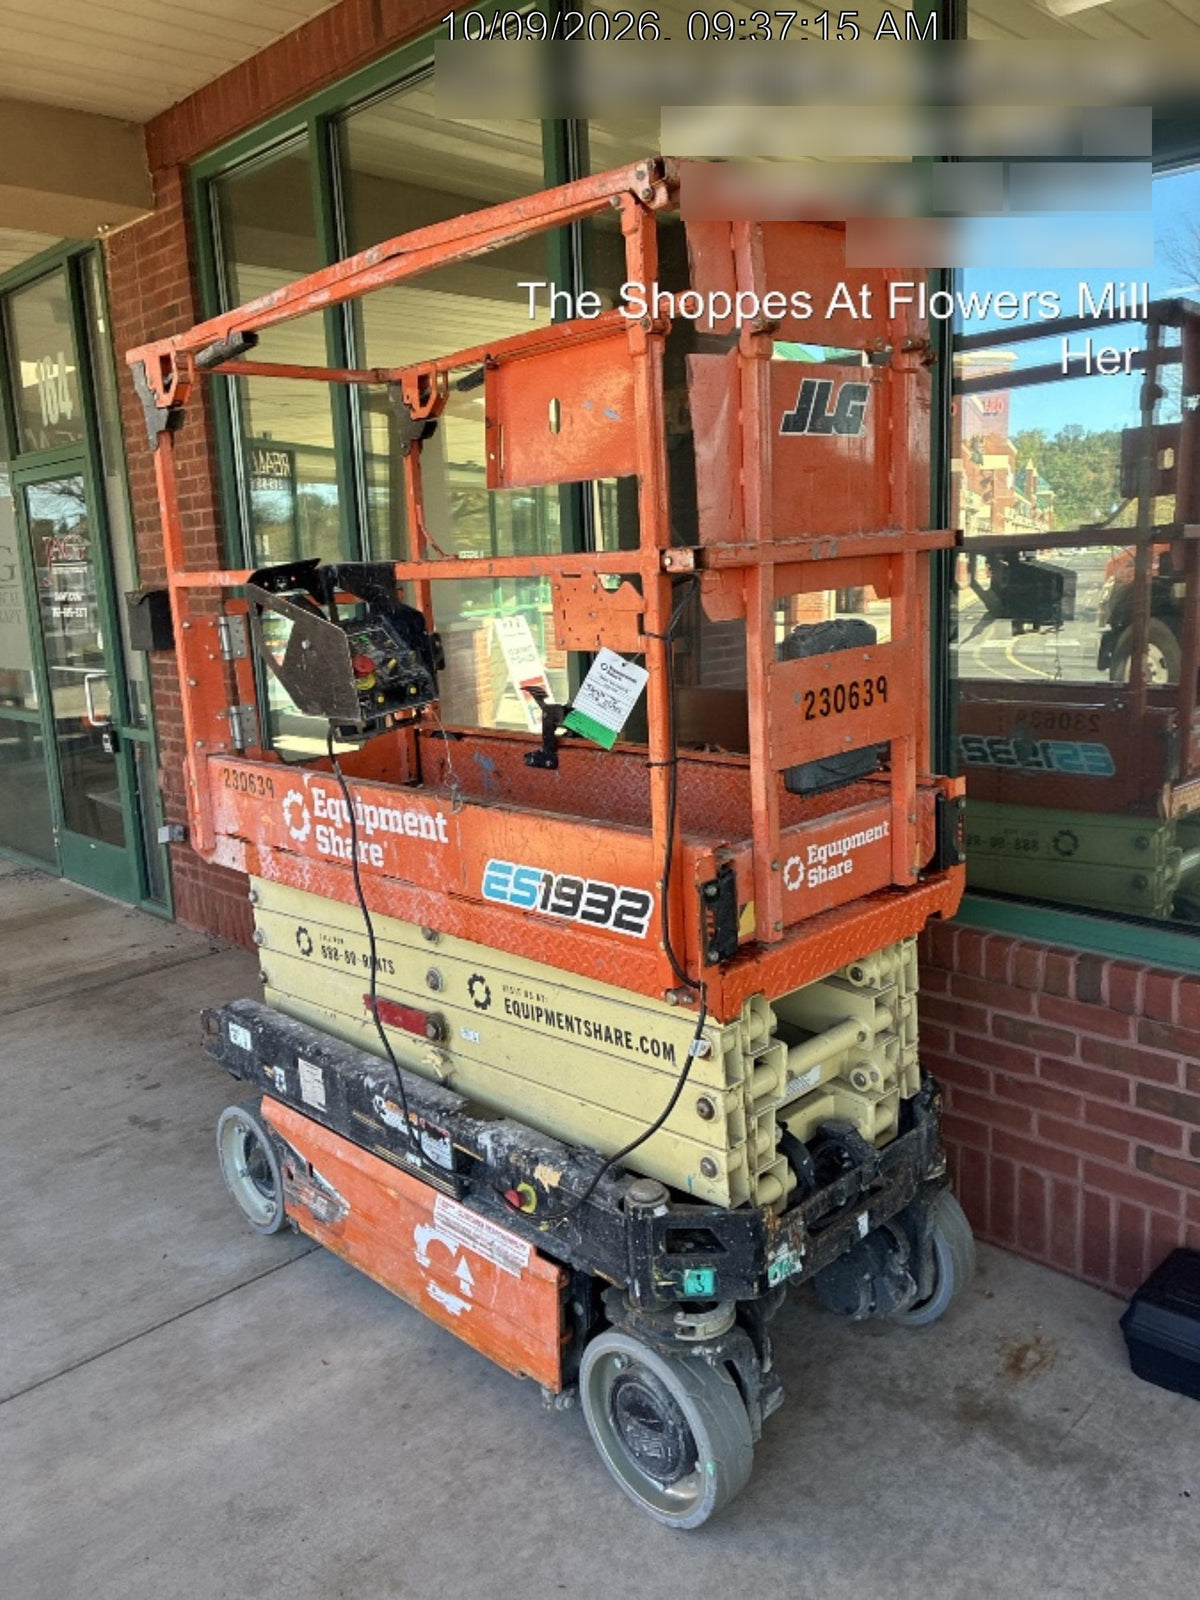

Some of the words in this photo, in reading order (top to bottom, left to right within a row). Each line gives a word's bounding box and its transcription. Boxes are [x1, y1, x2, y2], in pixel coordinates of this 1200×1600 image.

[779, 378, 872, 437] JLG
[804, 675, 889, 721] 230639
[223, 767, 275, 799] 230639
[311, 786, 450, 844] Equipment
[315, 823, 385, 868] Share
[806, 820, 890, 865] Equipment
[807, 857, 854, 888] Share
[482, 859, 655, 938] ES1932
[504, 997, 676, 1064] EQUIPMENTSHARE.COM
